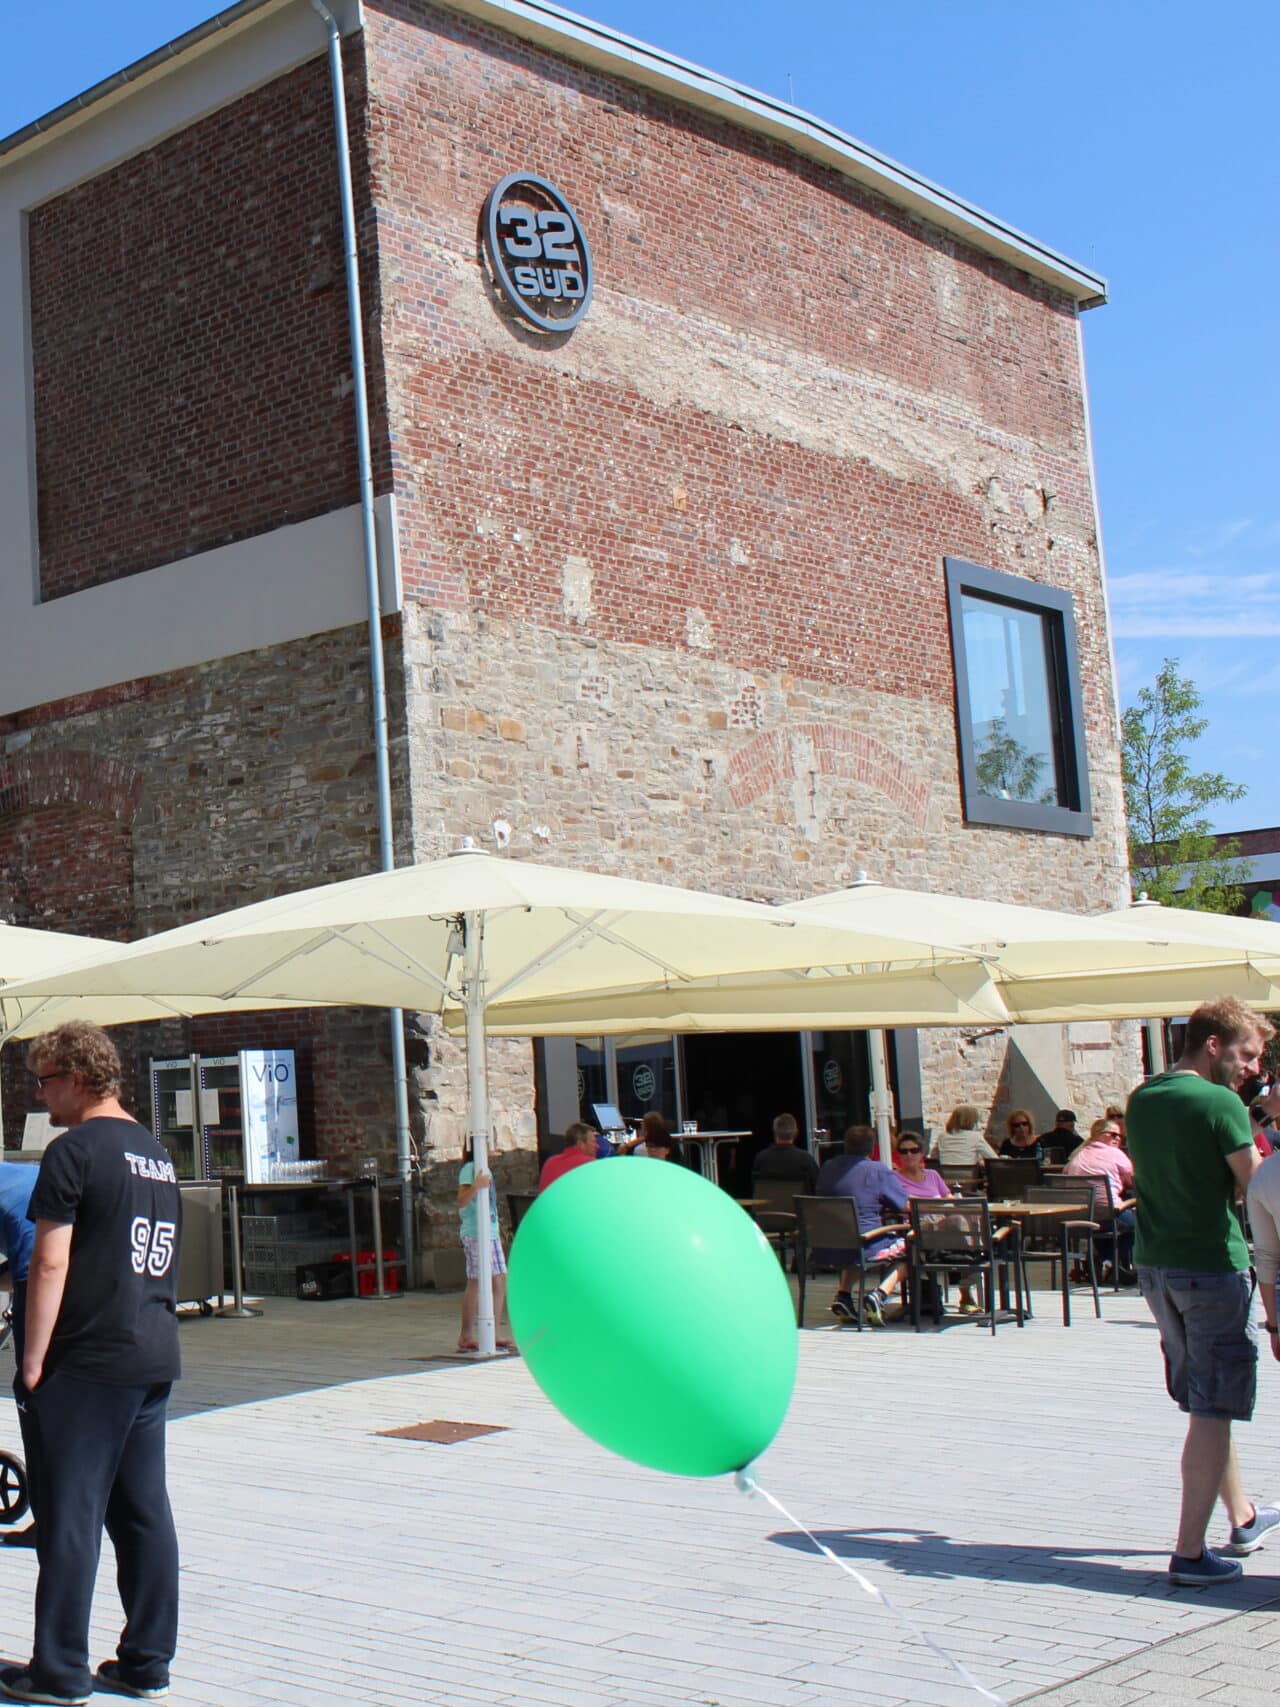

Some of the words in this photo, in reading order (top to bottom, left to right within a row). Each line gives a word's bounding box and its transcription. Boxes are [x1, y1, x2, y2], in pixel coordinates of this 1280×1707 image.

[499, 206, 580, 263] 32
[513, 266, 585, 298] SÜD
[252, 1063, 289, 1083] ViO
[123, 1151, 177, 1184] TEAM
[130, 1216, 176, 1277] 95
